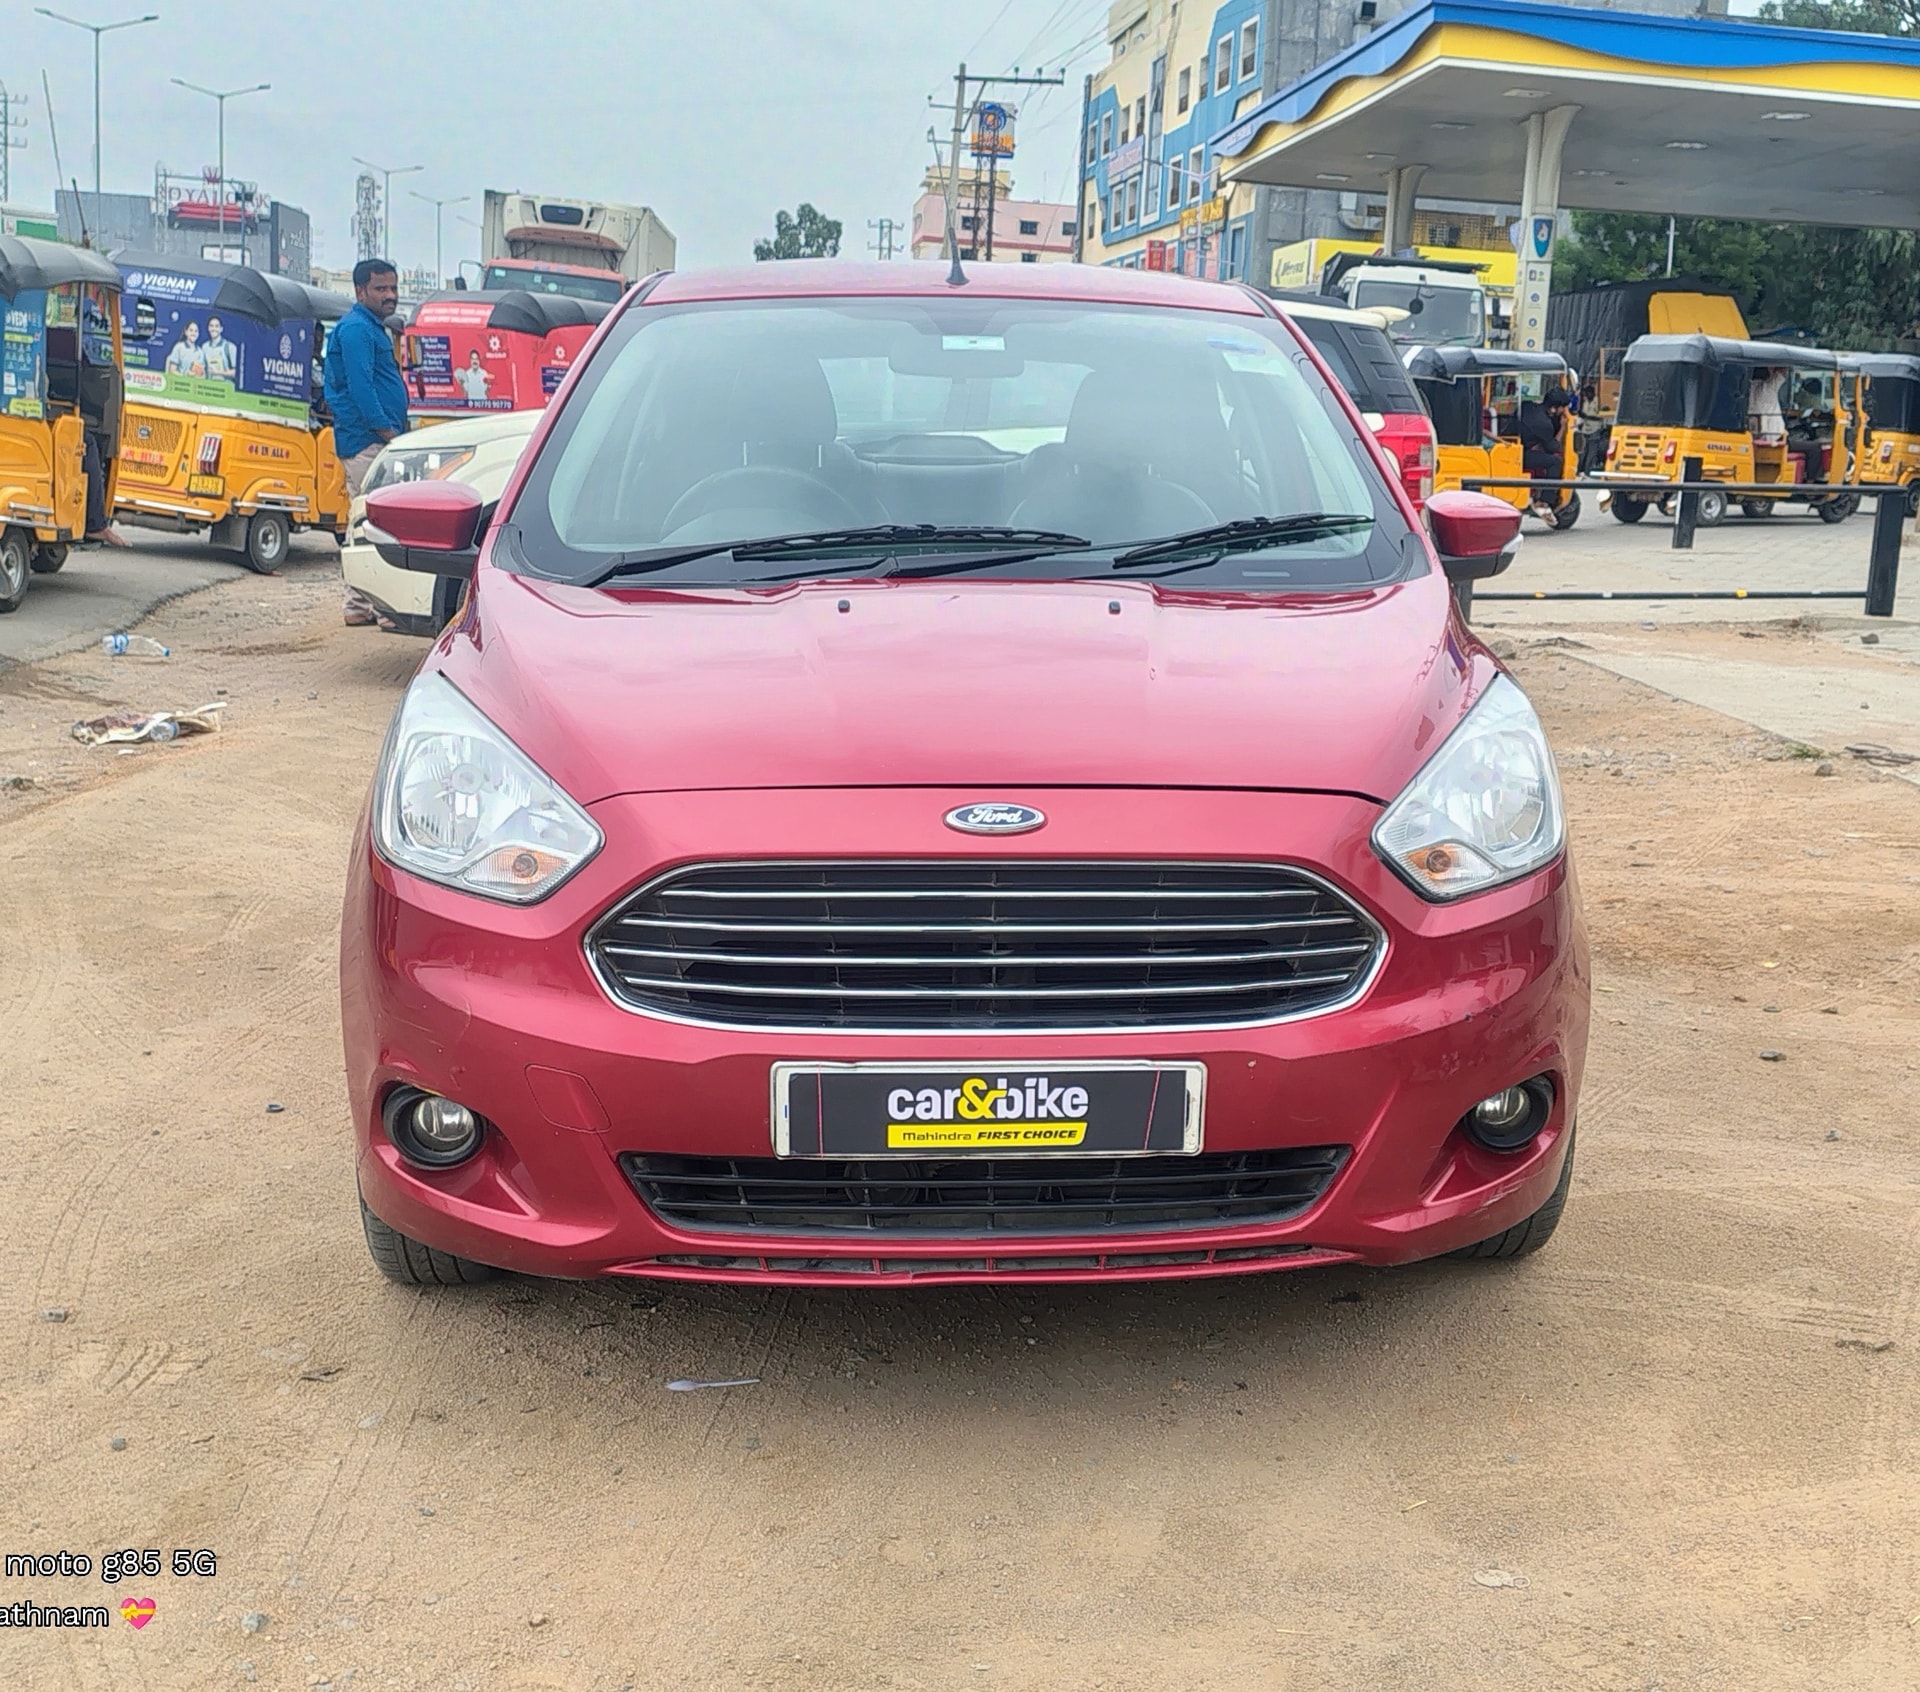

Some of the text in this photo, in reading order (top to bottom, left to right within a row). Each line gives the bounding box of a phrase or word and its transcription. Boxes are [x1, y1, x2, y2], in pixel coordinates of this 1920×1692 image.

[143, 272, 197, 291] VIGNAN
[263, 357, 304, 379] VIGNAN
[967, 805, 1022, 824] Ford
[887, 1077, 1089, 1120] car&bike
[902, 1129, 1077, 1141] Mahindra FIRST CHOICE
